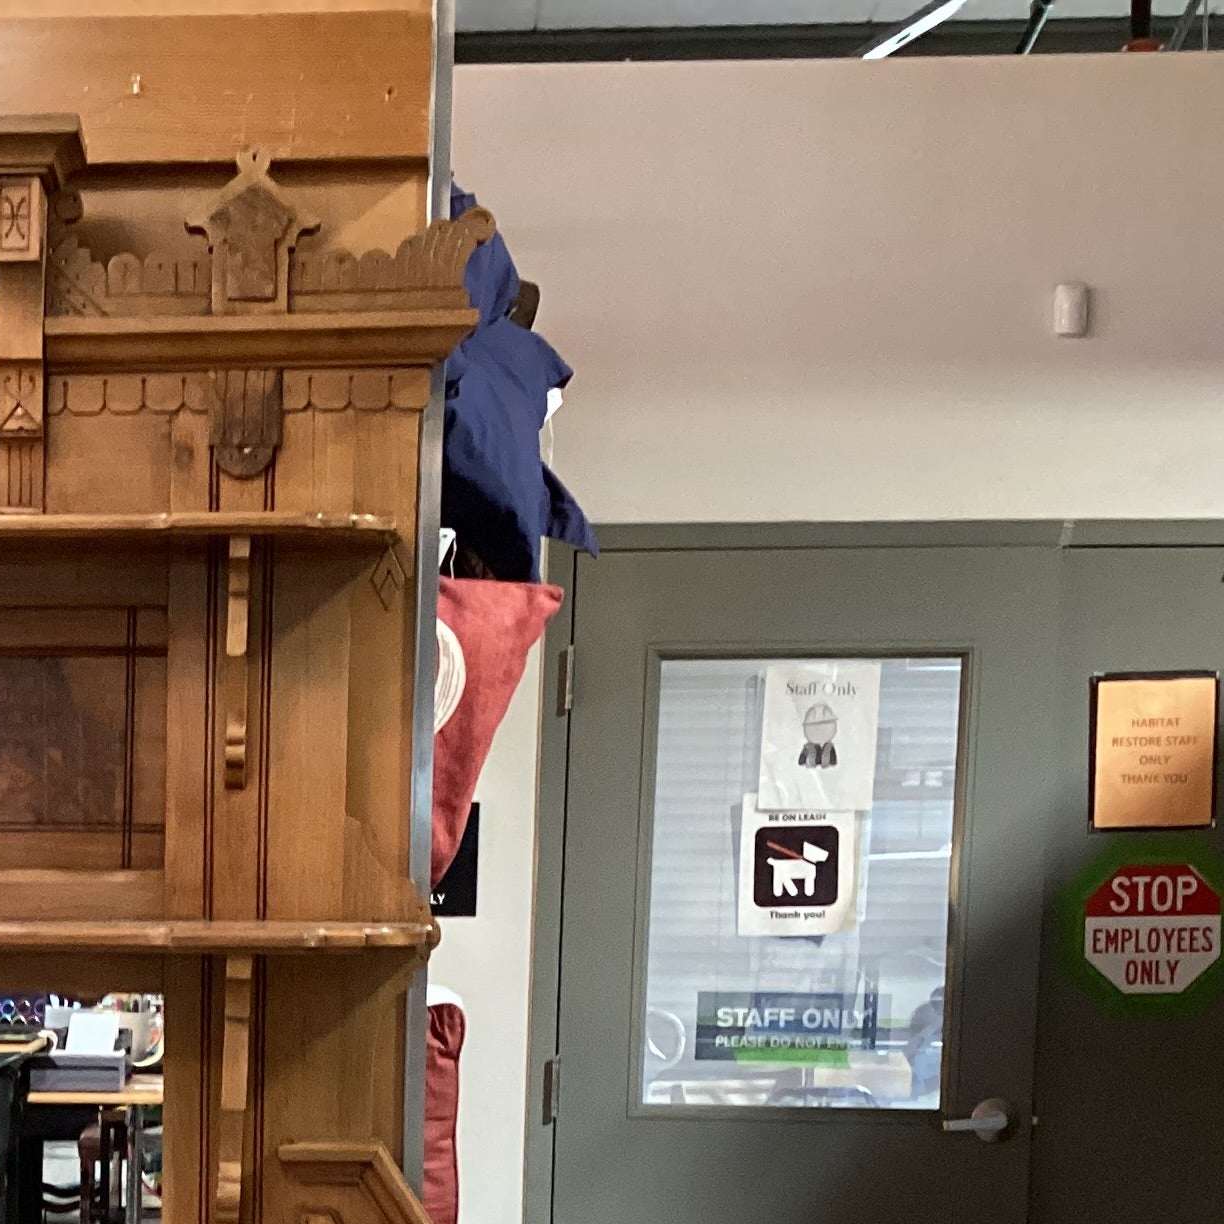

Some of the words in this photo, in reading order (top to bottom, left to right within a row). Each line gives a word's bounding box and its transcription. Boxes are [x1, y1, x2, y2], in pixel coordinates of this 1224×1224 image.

[785, 681, 817, 696] Staff
[822, 681, 857, 699] Only
[1131, 718, 1181, 729] HABITAT
[1111, 737, 1162, 748] RESTORE
[1139, 755, 1171, 766] ONLY
[1120, 774, 1160, 785] THANK
[1163, 774, 1188, 784] YOU
[769, 814, 780, 822] BE
[782, 814, 797, 822] ON
[798, 813, 827, 821] LEASH
[1109, 875, 1198, 913] STOP
[770, 911, 801, 919] Thank
[803, 911, 826, 921] you!
[1092, 926, 1214, 954] EMPLOYEES
[1124, 960, 1181, 986] ONLY
[716, 1006, 796, 1029] STAFF
[801, 1007, 866, 1029] ONLY
[714, 1034, 767, 1048] PLEASE
[769, 1036, 790, 1048] DO
[794, 1036, 823, 1049] NOT
